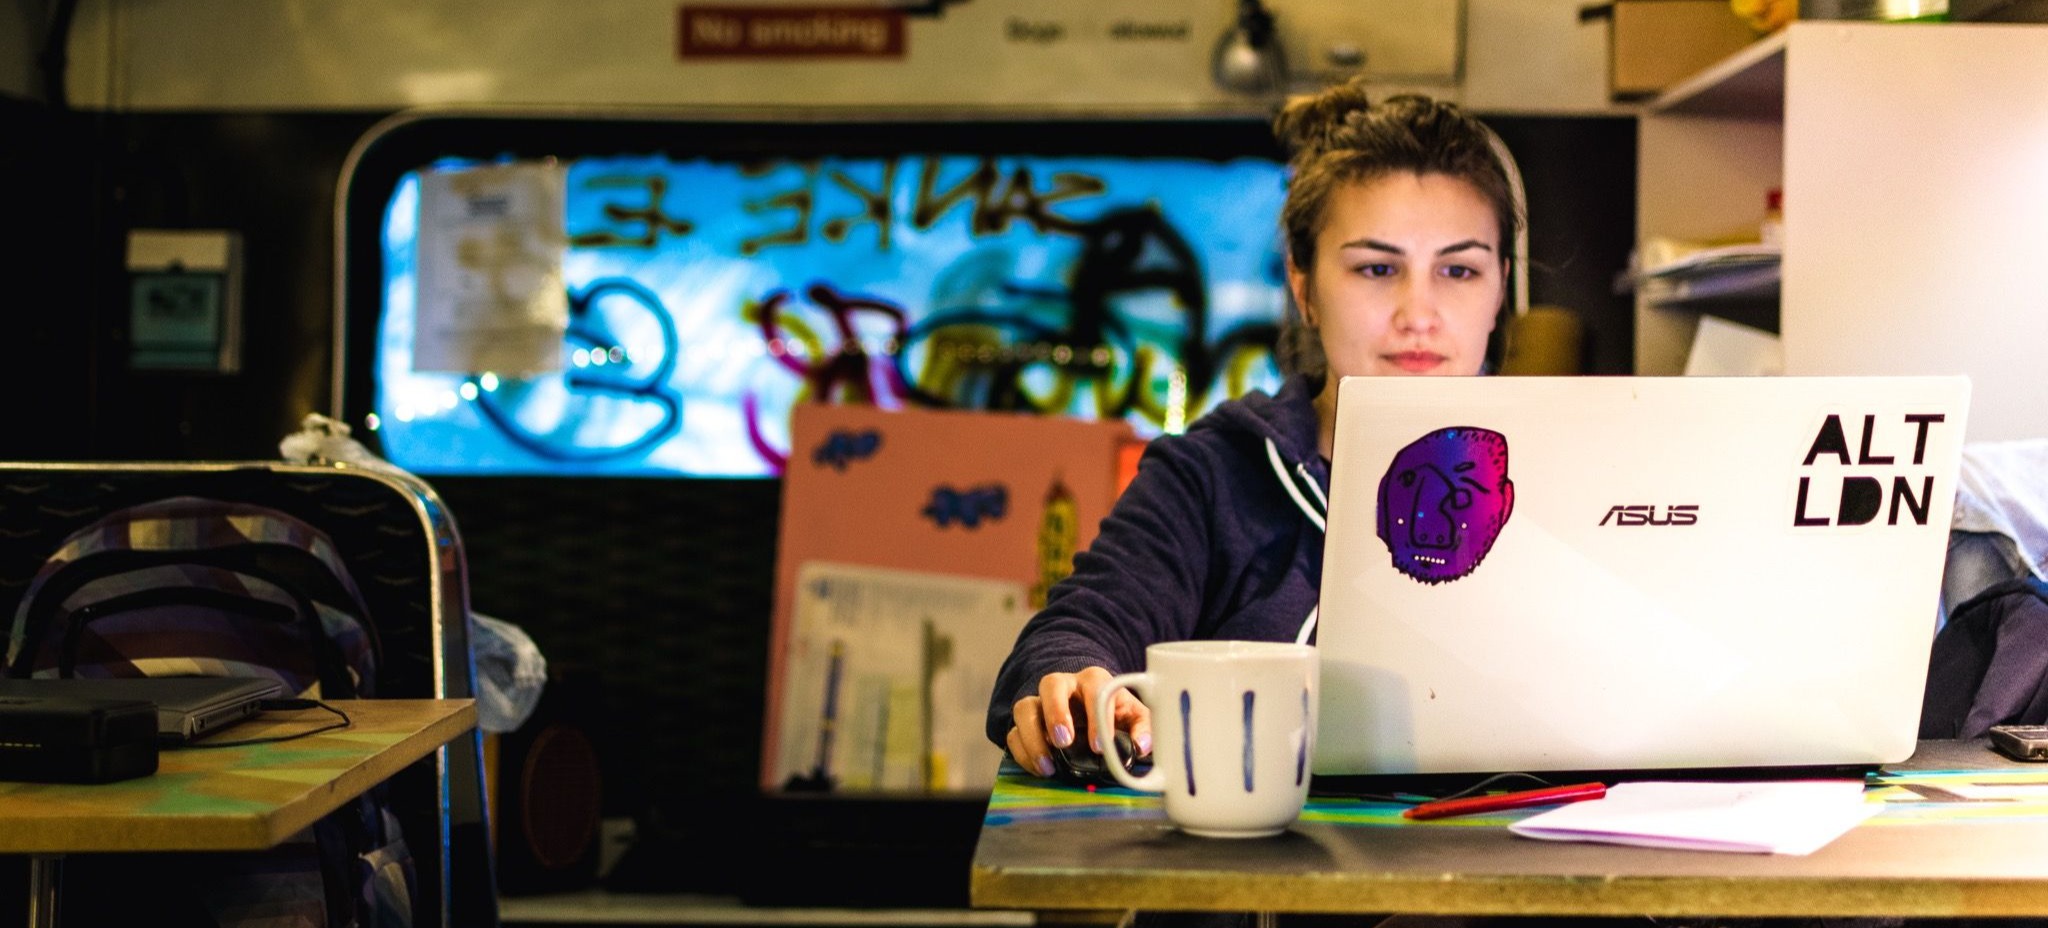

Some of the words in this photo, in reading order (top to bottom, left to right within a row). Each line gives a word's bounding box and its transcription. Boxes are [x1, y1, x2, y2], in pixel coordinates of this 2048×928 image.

[692, 14, 741, 47] No
[748, 13, 887, 52] smoking
[1802, 413, 1945, 466] ALT
[1599, 505, 1699, 526] ASUS
[1794, 476, 1935, 527] LDN
